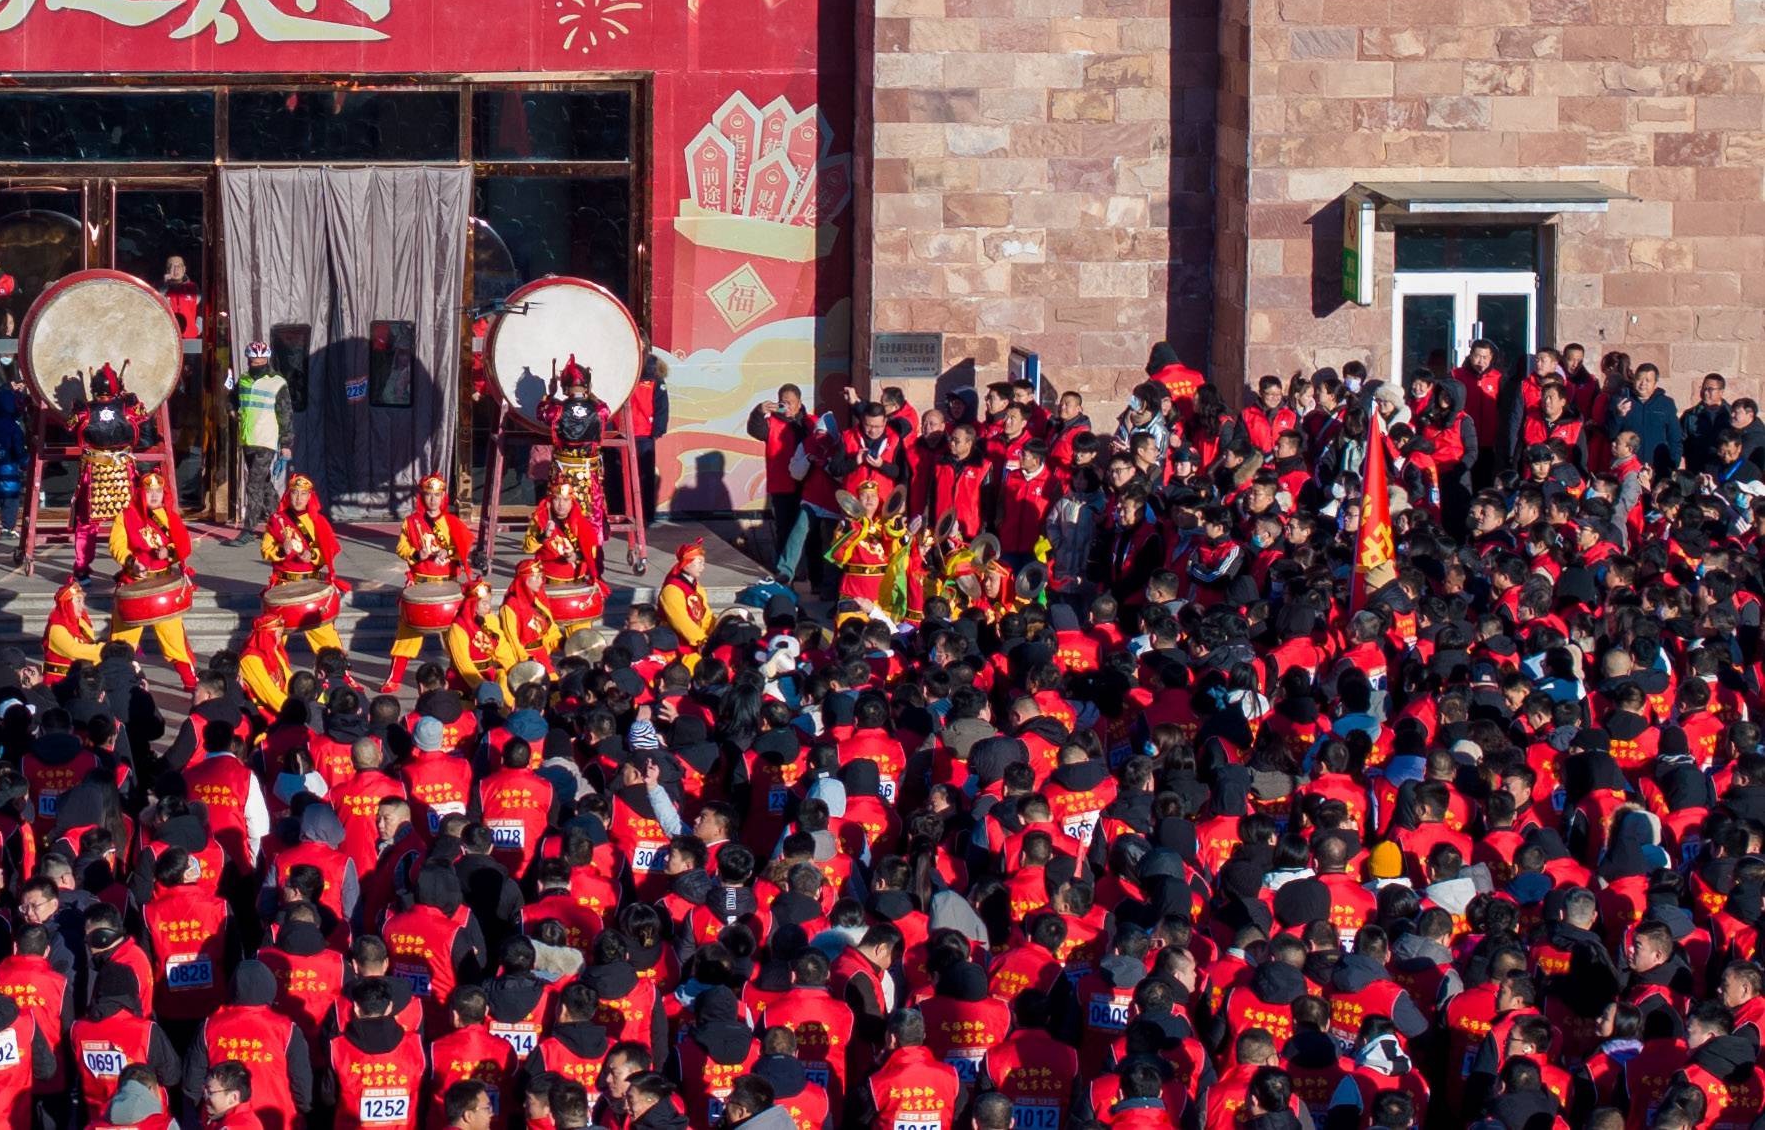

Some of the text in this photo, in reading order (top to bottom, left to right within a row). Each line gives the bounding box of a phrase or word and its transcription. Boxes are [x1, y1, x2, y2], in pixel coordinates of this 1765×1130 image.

[702, 166, 721, 210] 前途
[725, 280, 759, 315] 福
[171, 963, 210, 983] 0828
[88, 1053, 123, 1073] 0691
[364, 1099, 406, 1118] 1252
[1016, 1108, 1057, 1129] 1012
